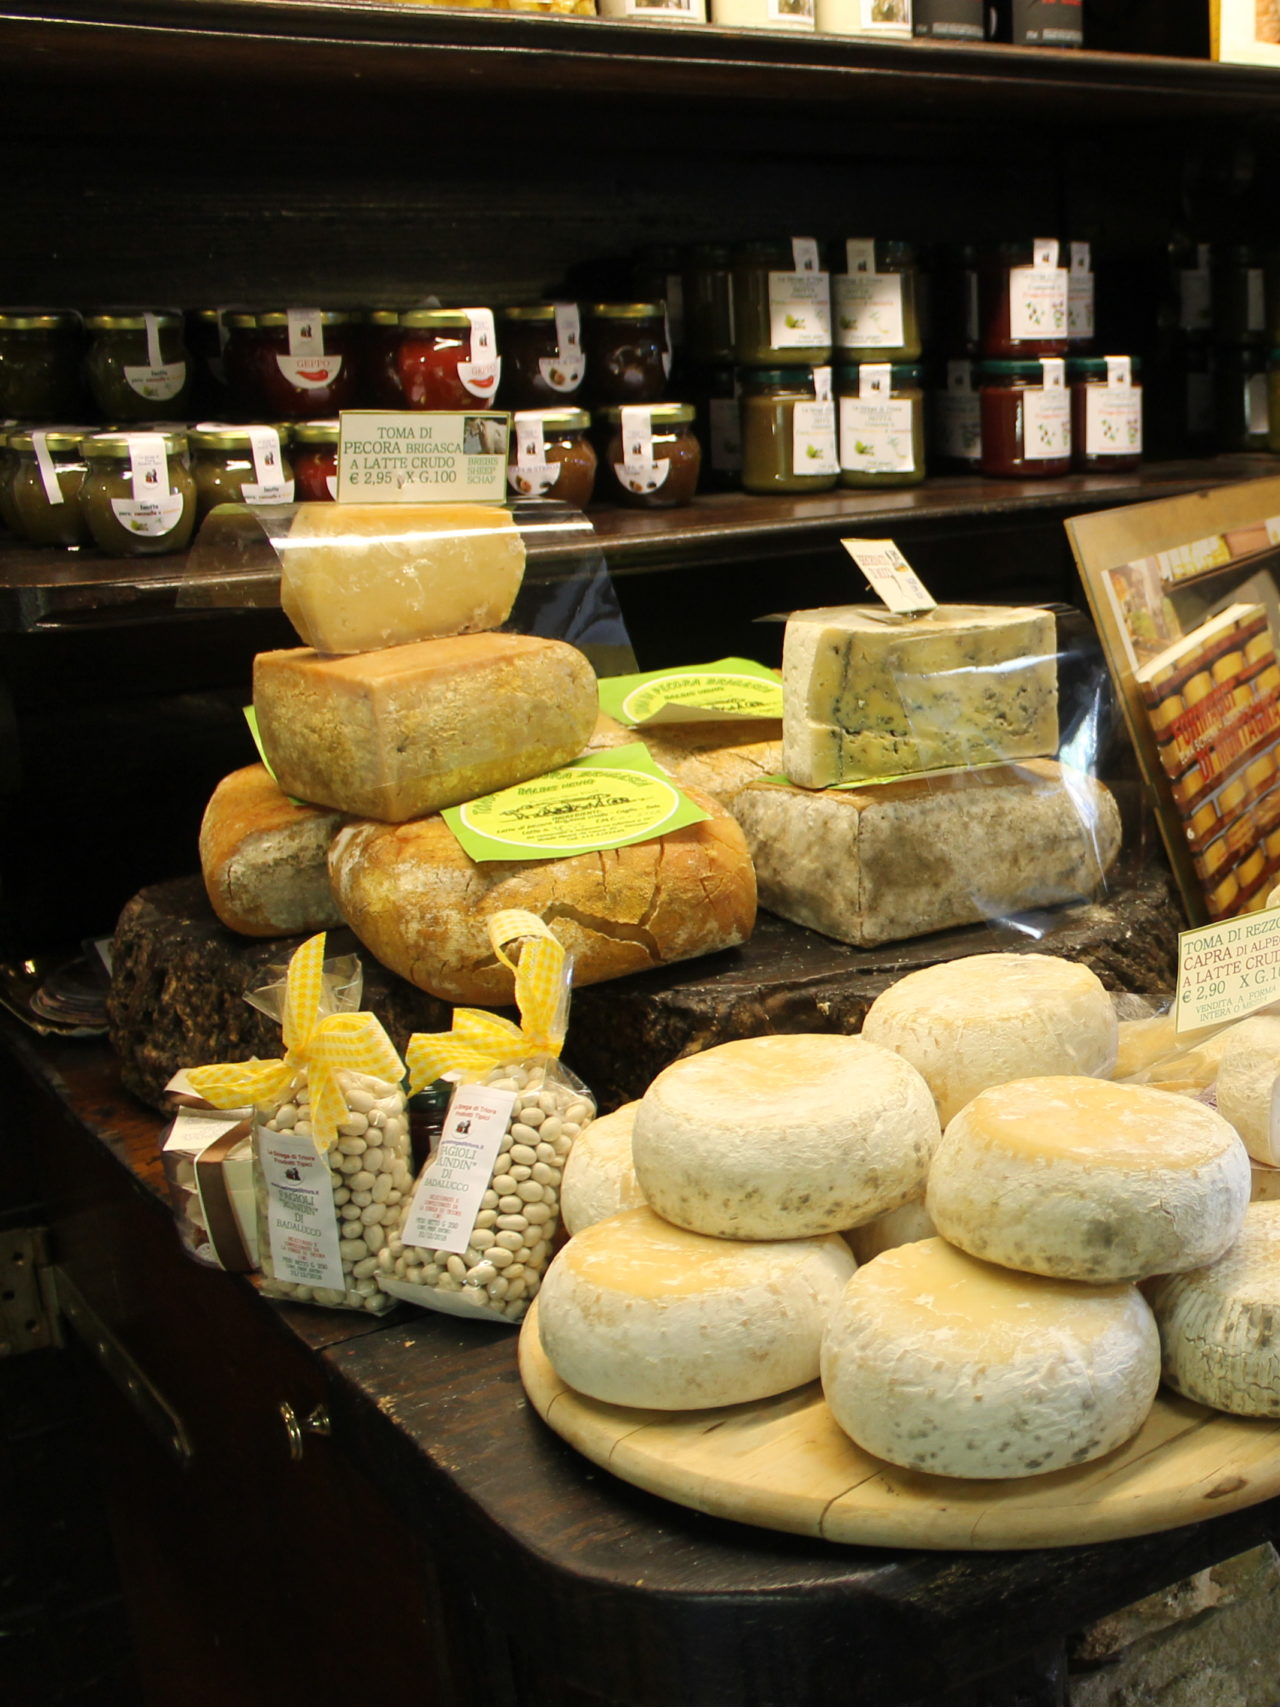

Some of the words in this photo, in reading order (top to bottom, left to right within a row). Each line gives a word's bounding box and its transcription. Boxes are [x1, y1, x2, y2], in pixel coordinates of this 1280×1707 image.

[377, 427, 415, 439] TOMA
[419, 427, 433, 439] DI
[344, 441, 401, 455] PECORA
[406, 443, 463, 454] BRIGASCA
[350, 459, 359, 470] A
[364, 457, 408, 469] LATTE
[411, 457, 455, 469] CRUDO
[468, 457, 498, 466] BREBIS
[467, 466, 496, 475] SHEEP
[350, 472, 359, 485] €
[364, 471, 392, 485] 2,95
[406, 471, 415, 483] X
[419, 471, 457, 483] G.100
[1184, 934, 1223, 955] TOMA
[1227, 928, 1242, 943] DI
[1183, 947, 1232, 971] CAPRA
[1236, 945, 1248, 957] DI
[1182, 975, 1192, 989] A
[1196, 962, 1242, 985] LATTE
[1182, 990, 1192, 1004] €
[1196, 980, 1226, 1001] 2,90
[1240, 975, 1250, 989] X
[1195, 997, 1233, 1014] VENDITA
[1200, 1008, 1231, 1022] INTERA
[441, 1168, 453, 1179] DI
[294, 1212, 304, 1223] DI
[276, 1218, 321, 1237] BADALUCCO
